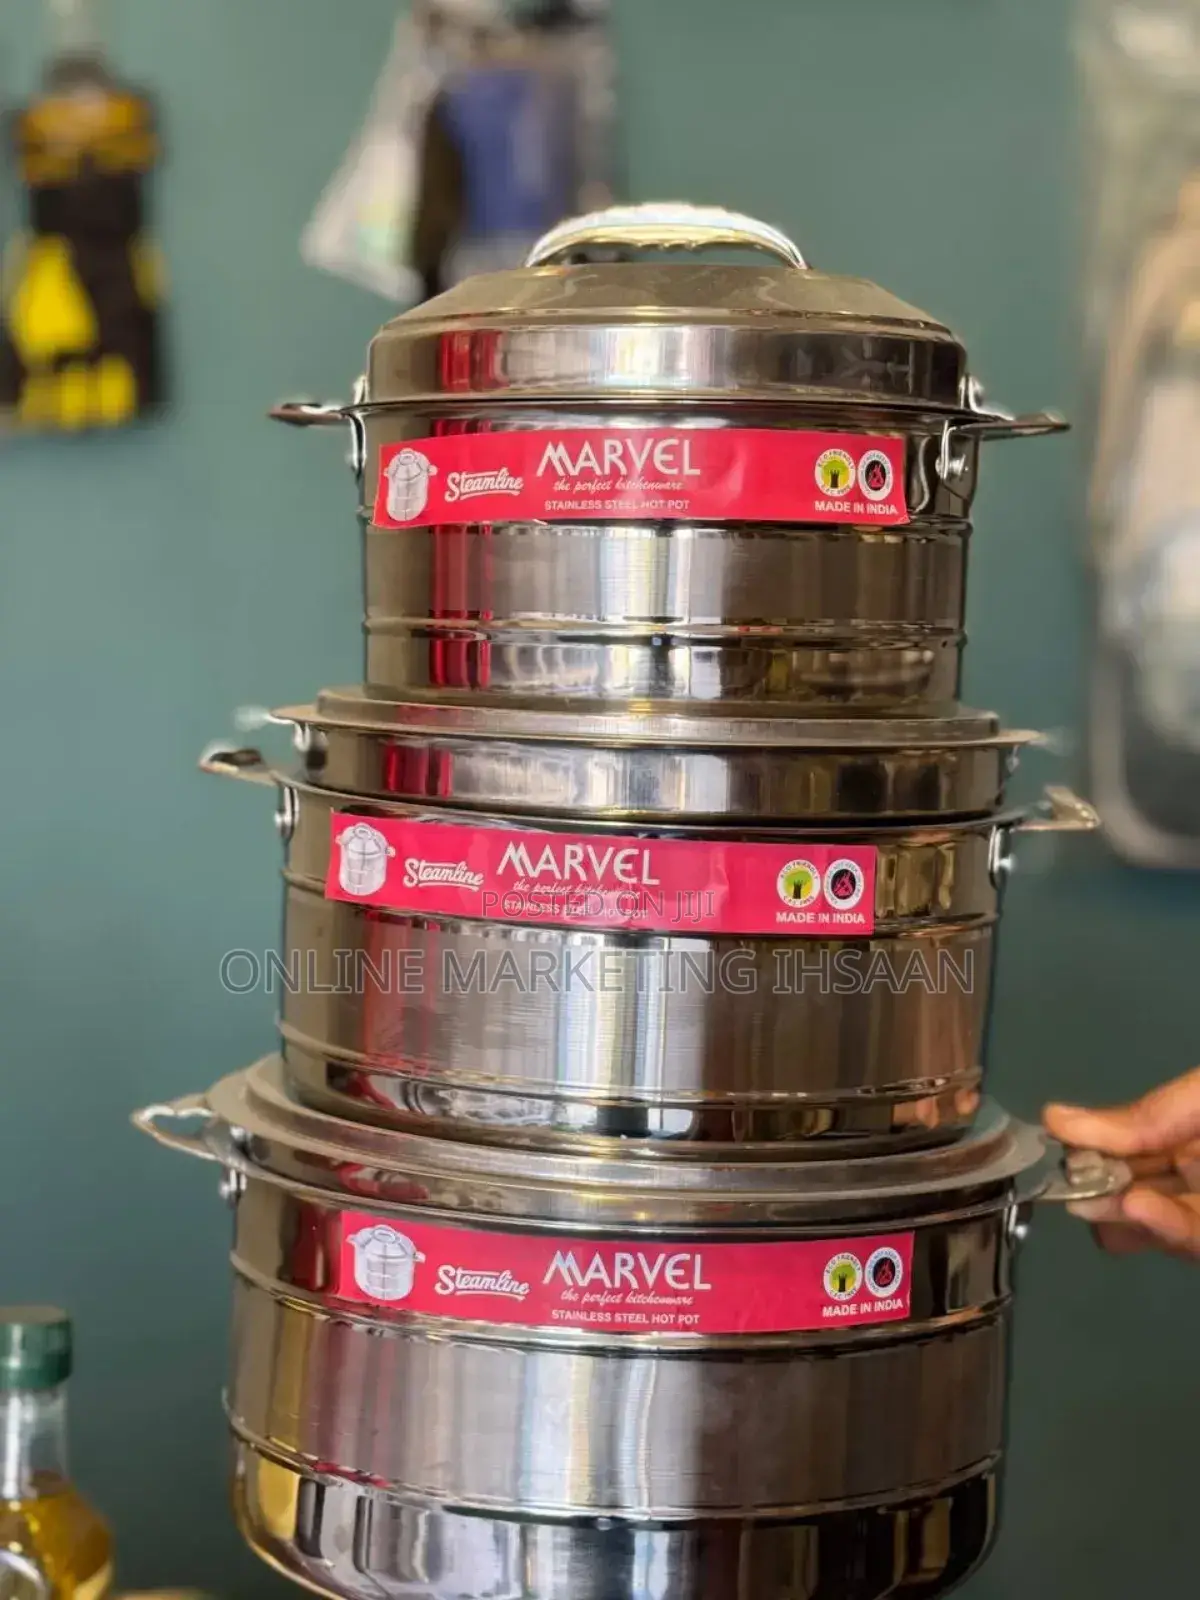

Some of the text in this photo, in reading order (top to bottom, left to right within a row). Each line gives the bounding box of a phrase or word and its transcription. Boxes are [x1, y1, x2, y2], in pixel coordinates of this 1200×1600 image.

[536, 439, 701, 477] MARVEL
[444, 467, 524, 502] Steamline
[553, 476, 684, 495] the perfect kitchenware
[545, 500, 690, 511] STAINLESS STEEL HOT POT
[815, 500, 898, 515] MADE IN INDIA
[496, 841, 660, 886] MARVEL
[403, 857, 484, 892] Steamline
[776, 911, 865, 924] MADE IN INDIA
[542, 1250, 712, 1290] MARVEL
[435, 1264, 530, 1301] Steamline
[561, 1288, 694, 1306] the perfect kitchenware
[552, 1309, 700, 1325] STAINLESS STEEL HOT POT
[822, 1298, 904, 1317] MADE IN INDIA
